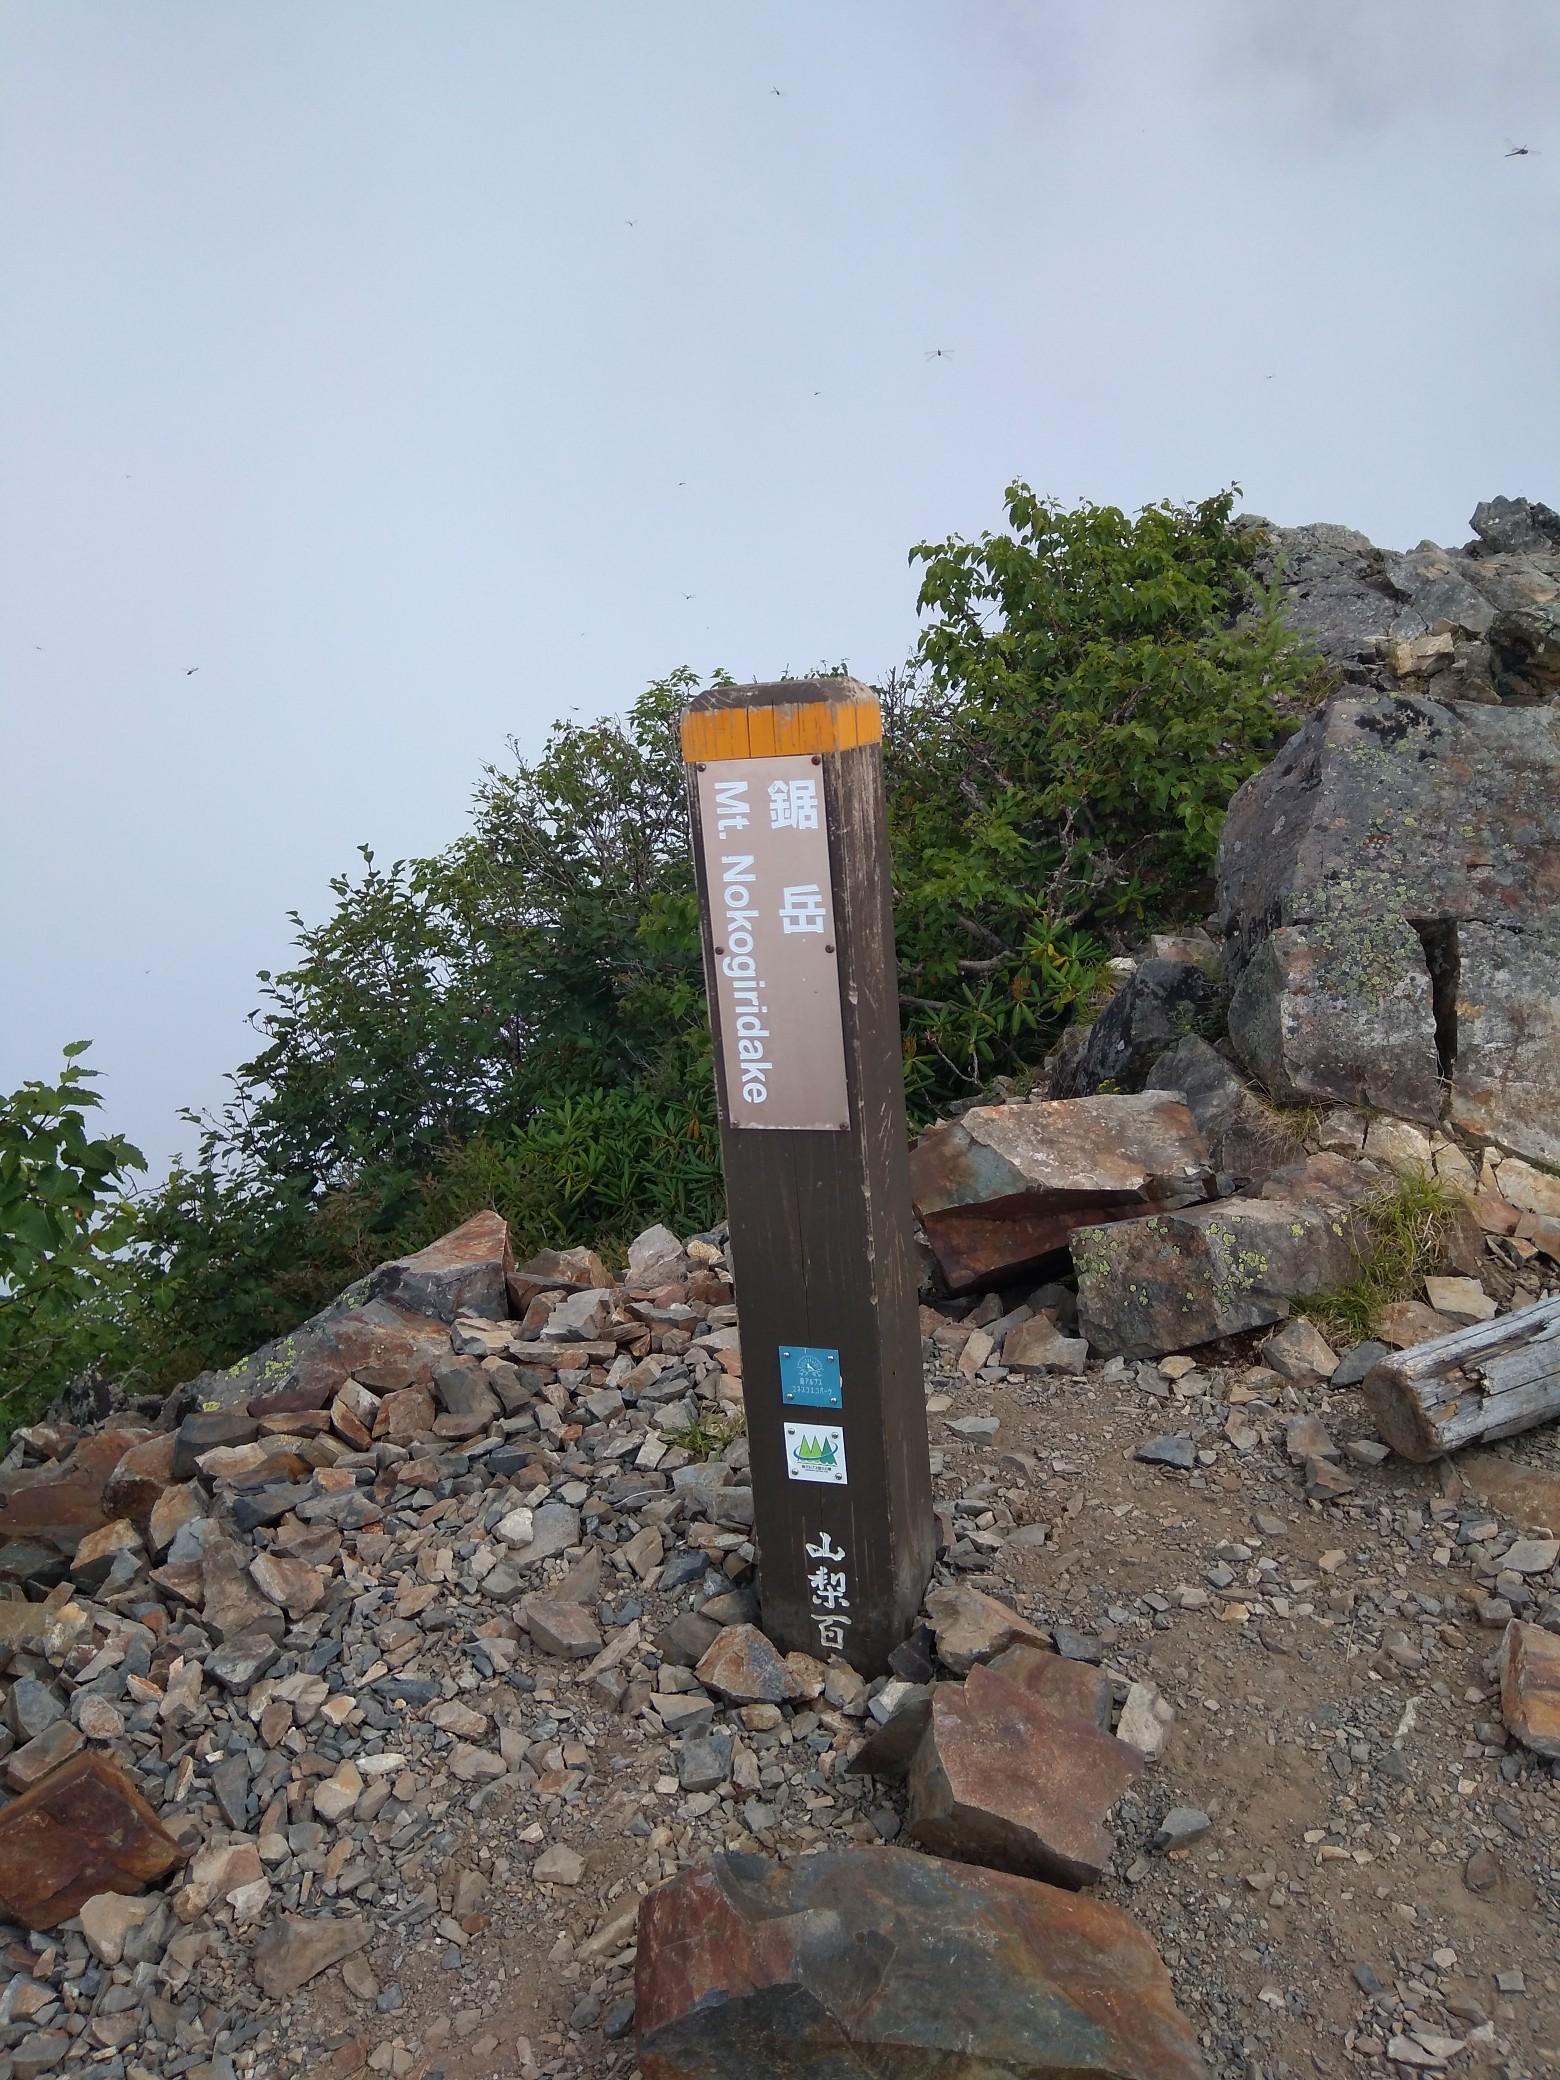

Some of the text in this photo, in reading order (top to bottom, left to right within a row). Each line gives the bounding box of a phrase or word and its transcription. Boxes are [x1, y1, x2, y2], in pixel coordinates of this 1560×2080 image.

[767, 779, 827, 935] 鋸岳
[714, 780, 774, 1105] Mt. Nokogiridake
[805, 1531, 852, 1650] 山梨百
